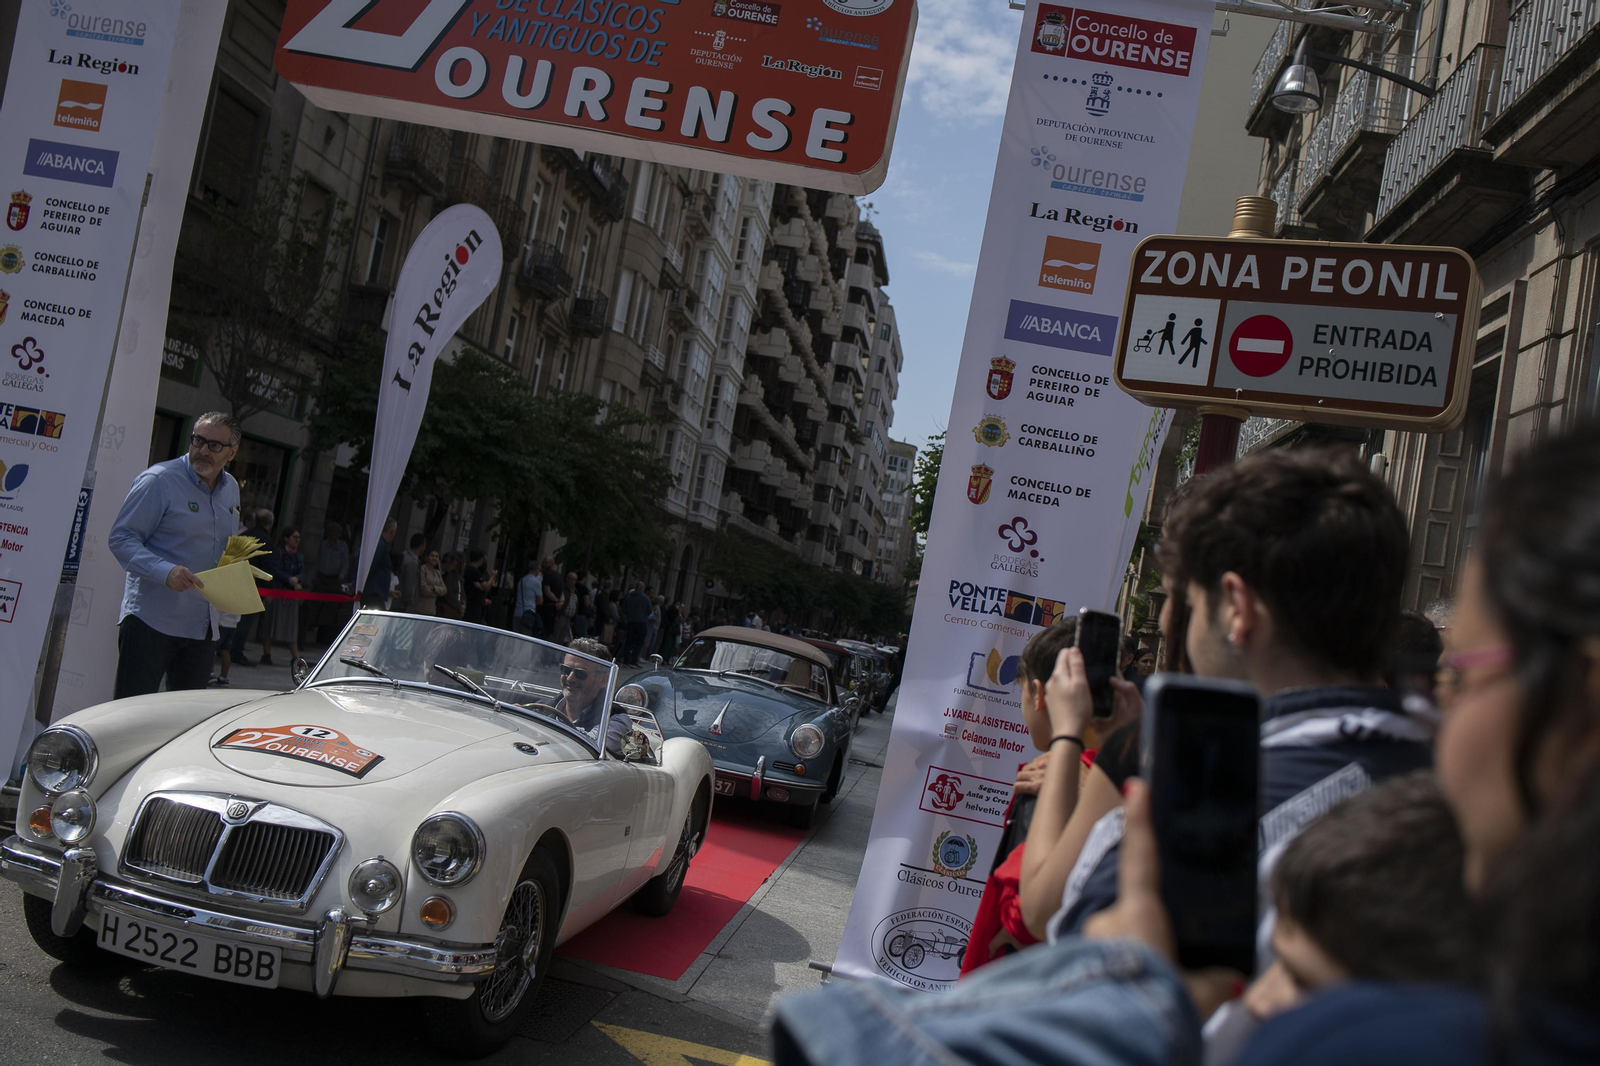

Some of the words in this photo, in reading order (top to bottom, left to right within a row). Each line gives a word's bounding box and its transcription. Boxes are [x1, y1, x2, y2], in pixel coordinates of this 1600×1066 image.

[730, 0, 762, 13] Concello
[763, 5, 772, 13] de
[854, 5, 886, 16] ANTIGUOS
[68, 13, 147, 37] ourense
[727, 9, 779, 25] OURENSE
[75, 31, 106, 42] capital
[108, 35, 135, 44] termal
[470, 11, 490, 36] Y
[486, 15, 626, 59] ANTIGUOS
[626, 37, 667, 66] DE
[820, 26, 880, 45] ourense
[1075, 15, 1148, 41] Concello
[1153, 29, 1173, 45] de
[690, 49, 743, 63] DEPUTACIÓN
[1071, 34, 1190, 70] OURENSE
[47, 49, 73, 66] La
[77, 52, 139, 75] Región
[695, 58, 734, 70] OURENSE
[762, 55, 785, 70] La
[787, 59, 842, 80] Región
[434, 46, 854, 163] OURENSE
[57, 113, 99, 128] telemiño
[1065, 133, 1078, 142] DE
[1079, 135, 1123, 149] OURENSE
[1098, 128, 1156, 144] PROVINCIAL
[1052, 164, 1147, 193] ourense
[1062, 183, 1097, 195] capital
[1099, 188, 1132, 200] termal
[46, 198, 95, 212] CONCELLO
[98, 206, 110, 215] DE
[43, 210, 86, 223] PEREIRO
[89, 217, 102, 226] DE
[1029, 202, 1059, 221] La
[1063, 207, 1138, 233] Región
[40, 221, 81, 235] AGUIAR
[34, 252, 84, 267] CONCELLO
[87, 260, 99, 270] DE
[32, 263, 97, 281] CARBALLIÑO
[1140, 250, 1261, 290] ZONA
[1280, 256, 1458, 301] PEONIL
[1042, 273, 1092, 290] telemiño
[24, 299, 76, 315] CONCELLO
[78, 309, 92, 319] DE
[391, 341, 425, 396] La
[413, 229, 484, 340] Región
[20, 312, 65, 327] MACEDA
[1313, 324, 1433, 353] ENTRADA
[168, 338, 181, 354] DE
[182, 342, 199, 360] LAS
[5, 371, 44, 385] BODEGAS
[1032, 365, 1090, 382] CONCELLO
[1094, 376, 1109, 386] DE
[1298, 356, 1438, 388] PROHIBIDA
[1, 378, 44, 393] GALLEGAS
[1029, 378, 1079, 394] PEREIRO
[1084, 387, 1100, 398] DE
[1026, 391, 1075, 407] AGUIAR
[1020, 424, 1079, 442] CONCELLO
[1083, 434, 1098, 445] DE
[31, 442, 37, 451] y
[38, 441, 59, 453] Ocio
[1018, 437, 1095, 458] CARBALLIÑO
[1010, 476, 1072, 495] CONCELLO
[1075, 487, 1092, 498] DE
[1007, 489, 1060, 507] MACEDA
[6, 504, 24, 513] LAUDE
[1, 539, 24, 553] Motor
[990, 562, 1039, 578] GALLEGAS
[993, 553, 1038, 569] BODEGAS
[949, 580, 1007, 602] PONTE
[949, 594, 1003, 617] VELLA
[944, 613, 978, 627] Centro
[980, 619, 1026, 638] Comercial
[1027, 631, 1033, 641] y
[953, 688, 987, 701] FUNDACIÓN
[988, 695, 1002, 704] CUM
[1002, 698, 1022, 709] LAUDE
[944, 708, 980, 724] J.VARELA
[981, 715, 1029, 735] ASISTENCIA
[221, 731, 295, 747] 27
[300, 727, 331, 739] 12
[962, 729, 997, 746] Celanova
[998, 738, 1025, 753] Motor
[266, 743, 360, 773] OURENSE
[972, 746, 1000, 759] Asistencia
[714, 781, 733, 793] 37
[966, 791, 984, 800] Anta
[978, 784, 1009, 796] Seguros
[965, 802, 1000, 816] helvetia
[897, 869, 944, 890] Clásicos
[890, 911, 943, 925] FEDERACIÓN
[101, 913, 120, 945] H
[124, 922, 199, 968] 2522
[213, 944, 275, 981] BBB
[878, 956, 925, 988] VEHÍCULOS
